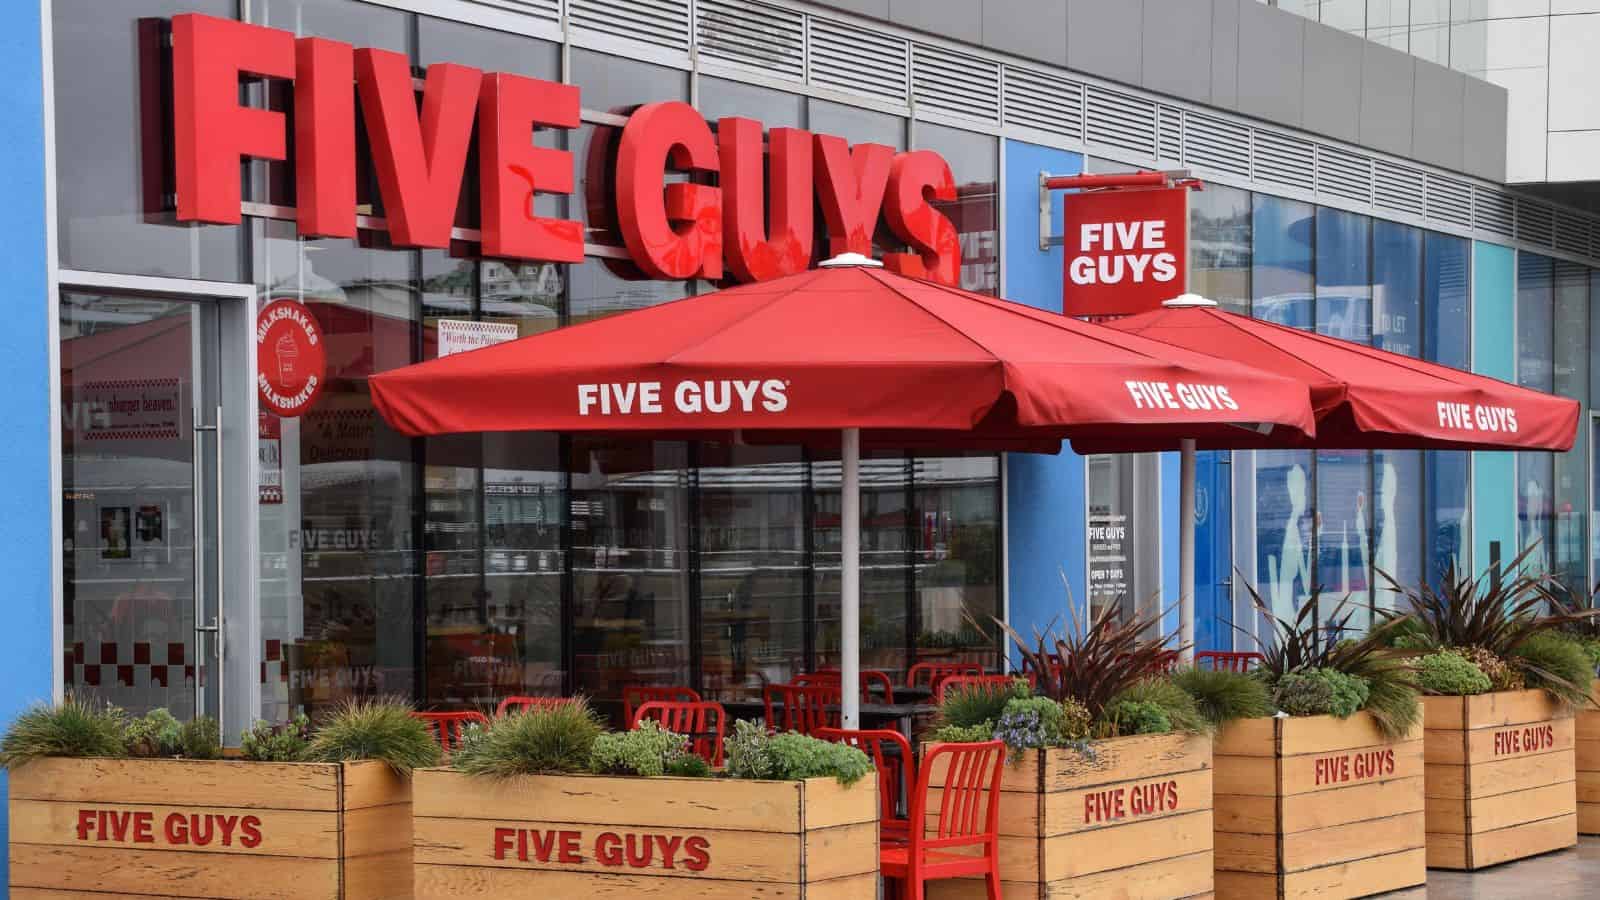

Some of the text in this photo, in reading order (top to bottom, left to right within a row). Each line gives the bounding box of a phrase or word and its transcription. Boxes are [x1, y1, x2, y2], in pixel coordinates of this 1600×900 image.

[172, 12, 961, 287] FIVE GUYS
[1080, 220, 1165, 251] FIVE
[1070, 252, 1176, 285] GUYS
[257, 307, 318, 345] MILKSHAKES
[259, 373, 317, 408] MILKSHAKES
[577, 379, 788, 415] FIVE GUYS
[1125, 381, 1239, 410] FIVE GUYS
[1437, 400, 1518, 432] FIVE GUYS
[1089, 527, 1125, 540] FIVE GUYS
[1494, 724, 1553, 756] FIVE GUYS
[1314, 749, 1395, 785] FIVE GUYS
[1084, 780, 1178, 824] FIVE GUYS
[77, 809, 262, 848] FIVE GUYS
[494, 827, 711, 872] FIVE GUYS
